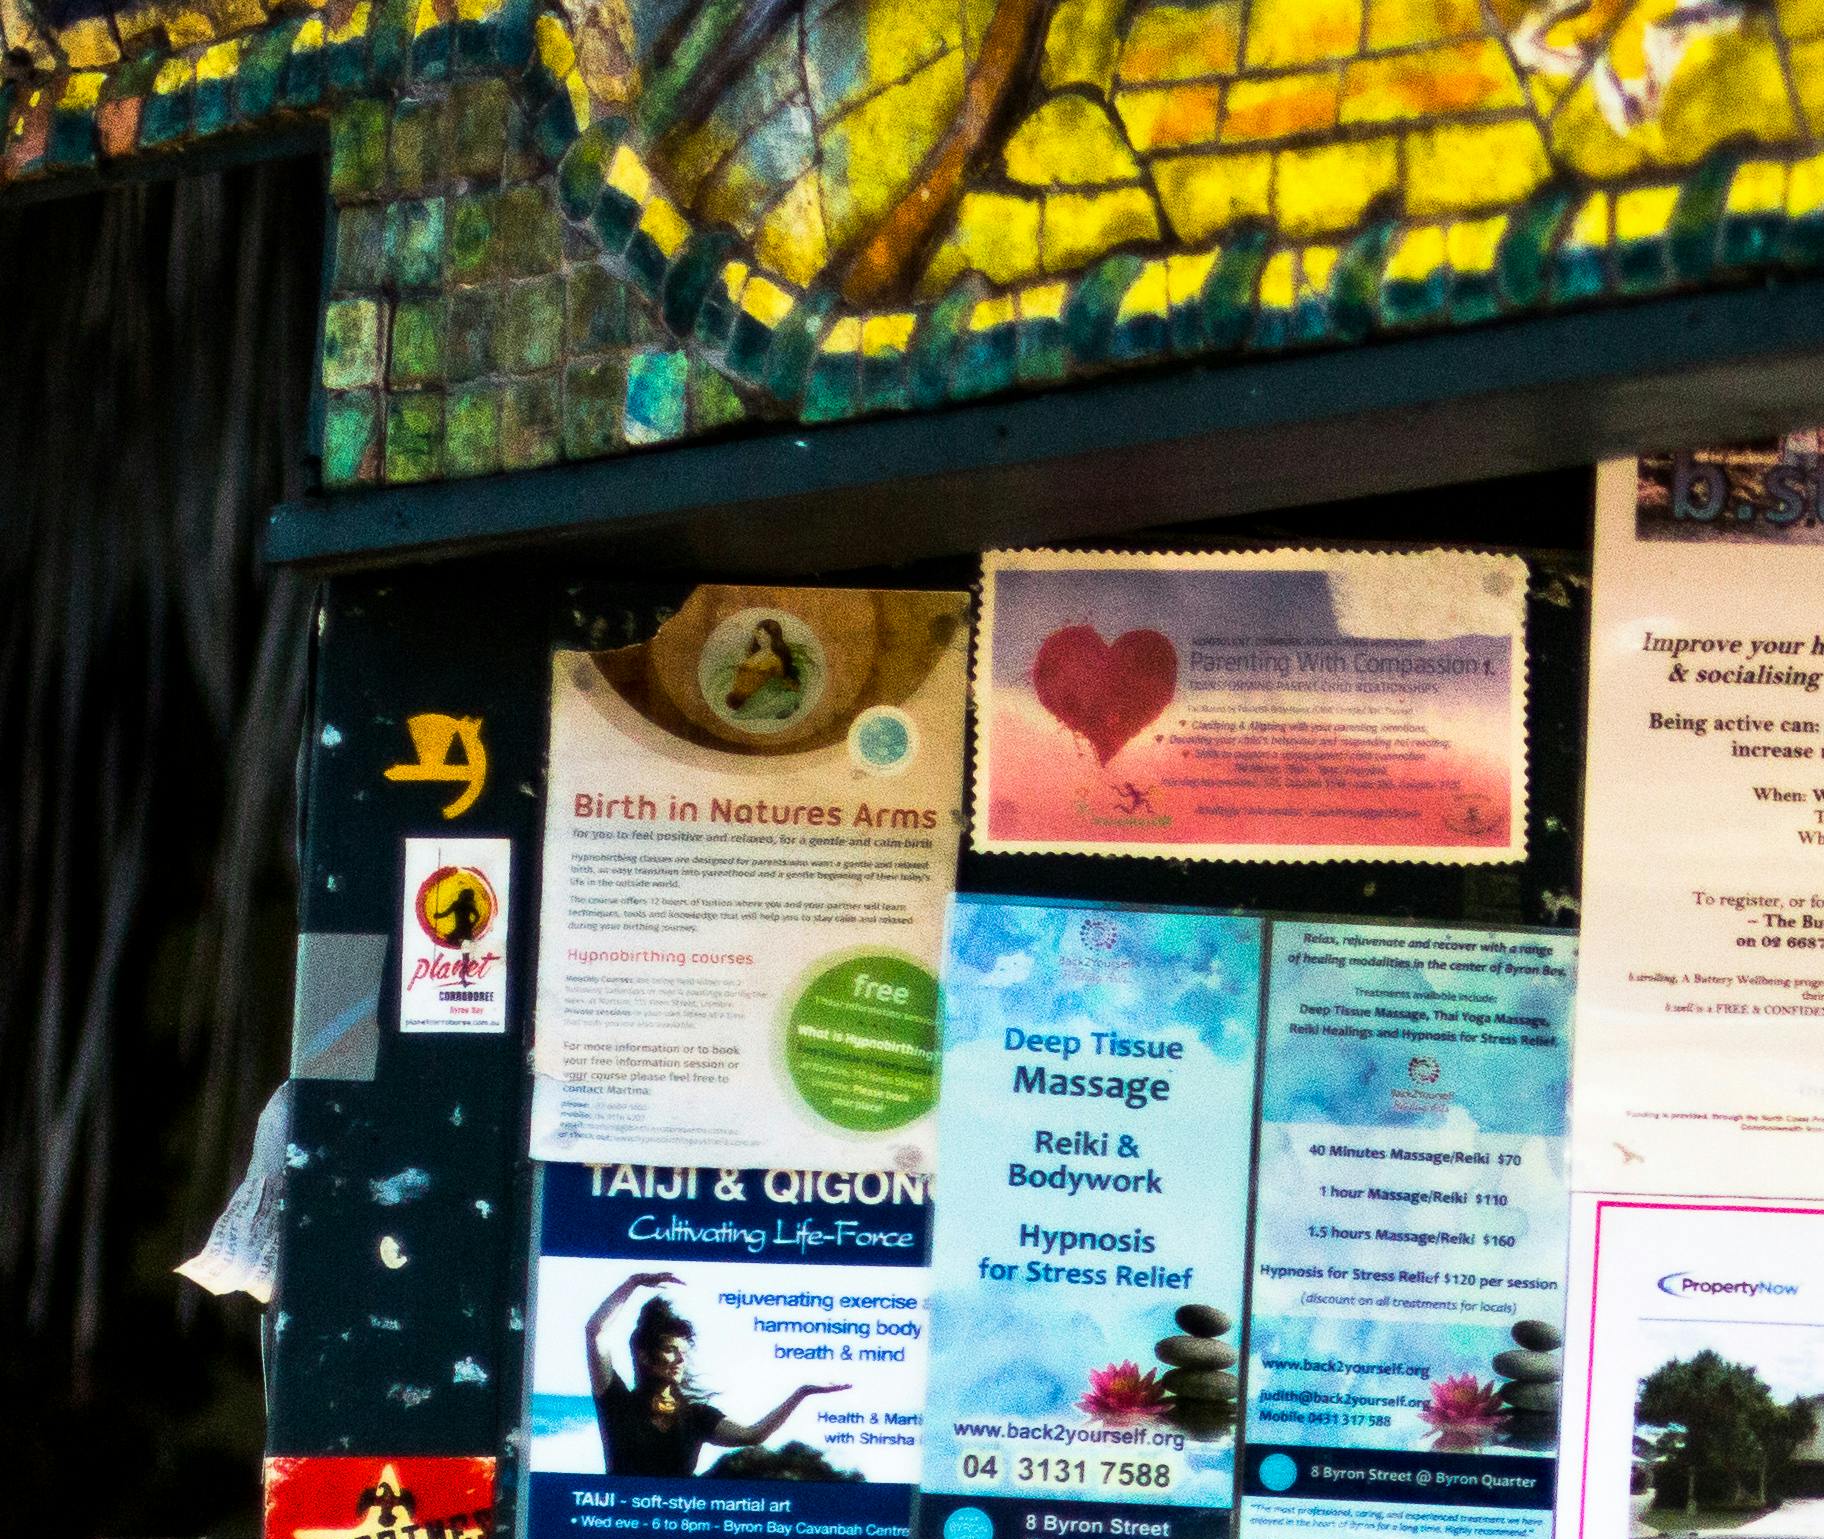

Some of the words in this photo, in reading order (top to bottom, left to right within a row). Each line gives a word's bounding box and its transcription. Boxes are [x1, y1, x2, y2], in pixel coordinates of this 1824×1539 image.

[1642, 631, 1741, 656] Improve
[1746, 636, 1805, 660] your
[1190, 650, 1291, 679] Parenting
[1298, 652, 1347, 674] With
[1353, 653, 1481, 679] Compassion
[573, 793, 657, 823] Birth
[669, 797, 697, 822] in
[709, 798, 841, 828] Natures
[853, 802, 938, 830] Arms
[407, 952, 502, 991] planet
[567, 947, 687, 967] Hypnobirthing
[691, 950, 754, 966] courses
[853, 973, 909, 1003] free
[1004, 1027, 1082, 1062] Deep
[1091, 1032, 1184, 1061] Tissue
[1013, 1066, 1171, 1109] Massage
[1035, 1131, 1108, 1157] Reiki
[1117, 1134, 1140, 1158] &
[715, 1170, 746, 1202] &
[1008, 1163, 1163, 1199] Bodywork
[628, 1215, 766, 1252] Cultivating
[772, 1217, 915, 1251] Life-Force
[1020, 1223, 1156, 1258] Hypnosis
[979, 1258, 1020, 1284] for
[1025, 1259, 1107, 1286] Stress
[1115, 1265, 1193, 1290] Relief
[1681, 1278, 1799, 1296] PropertyNow
[953, 1419, 1186, 1451] www.back2yourself.org
[963, 1454, 999, 1479] 04
[1018, 1457, 1087, 1484] 3131
[1101, 1459, 1171, 1487] 7588
